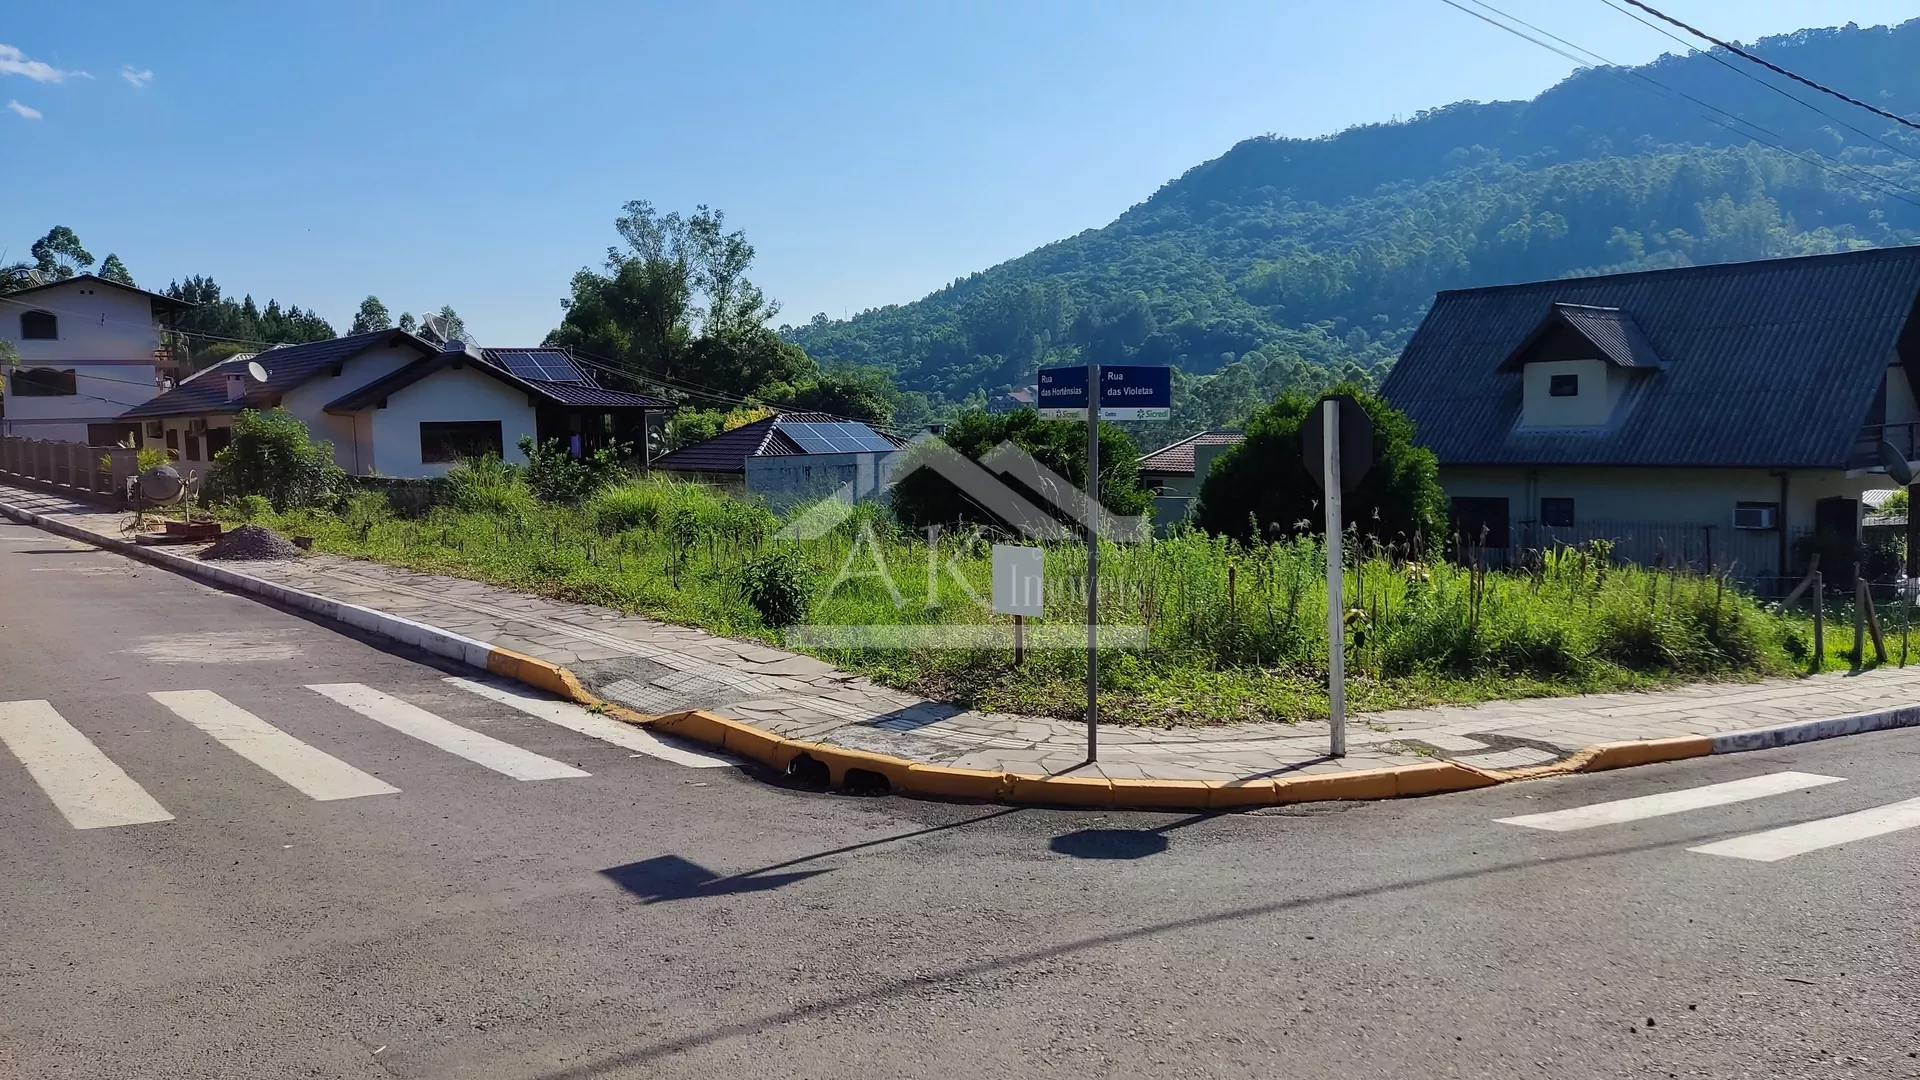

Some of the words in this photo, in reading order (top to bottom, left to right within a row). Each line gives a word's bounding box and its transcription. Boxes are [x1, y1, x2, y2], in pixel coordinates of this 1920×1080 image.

[1041, 375, 1053, 384] Rua
[1107, 371, 1124, 381] Rua
[1040, 388, 1052, 397] das
[1052, 386, 1082, 396] Hortênsias
[1107, 387, 1122, 396] das
[1122, 386, 1154, 396] Violetas
